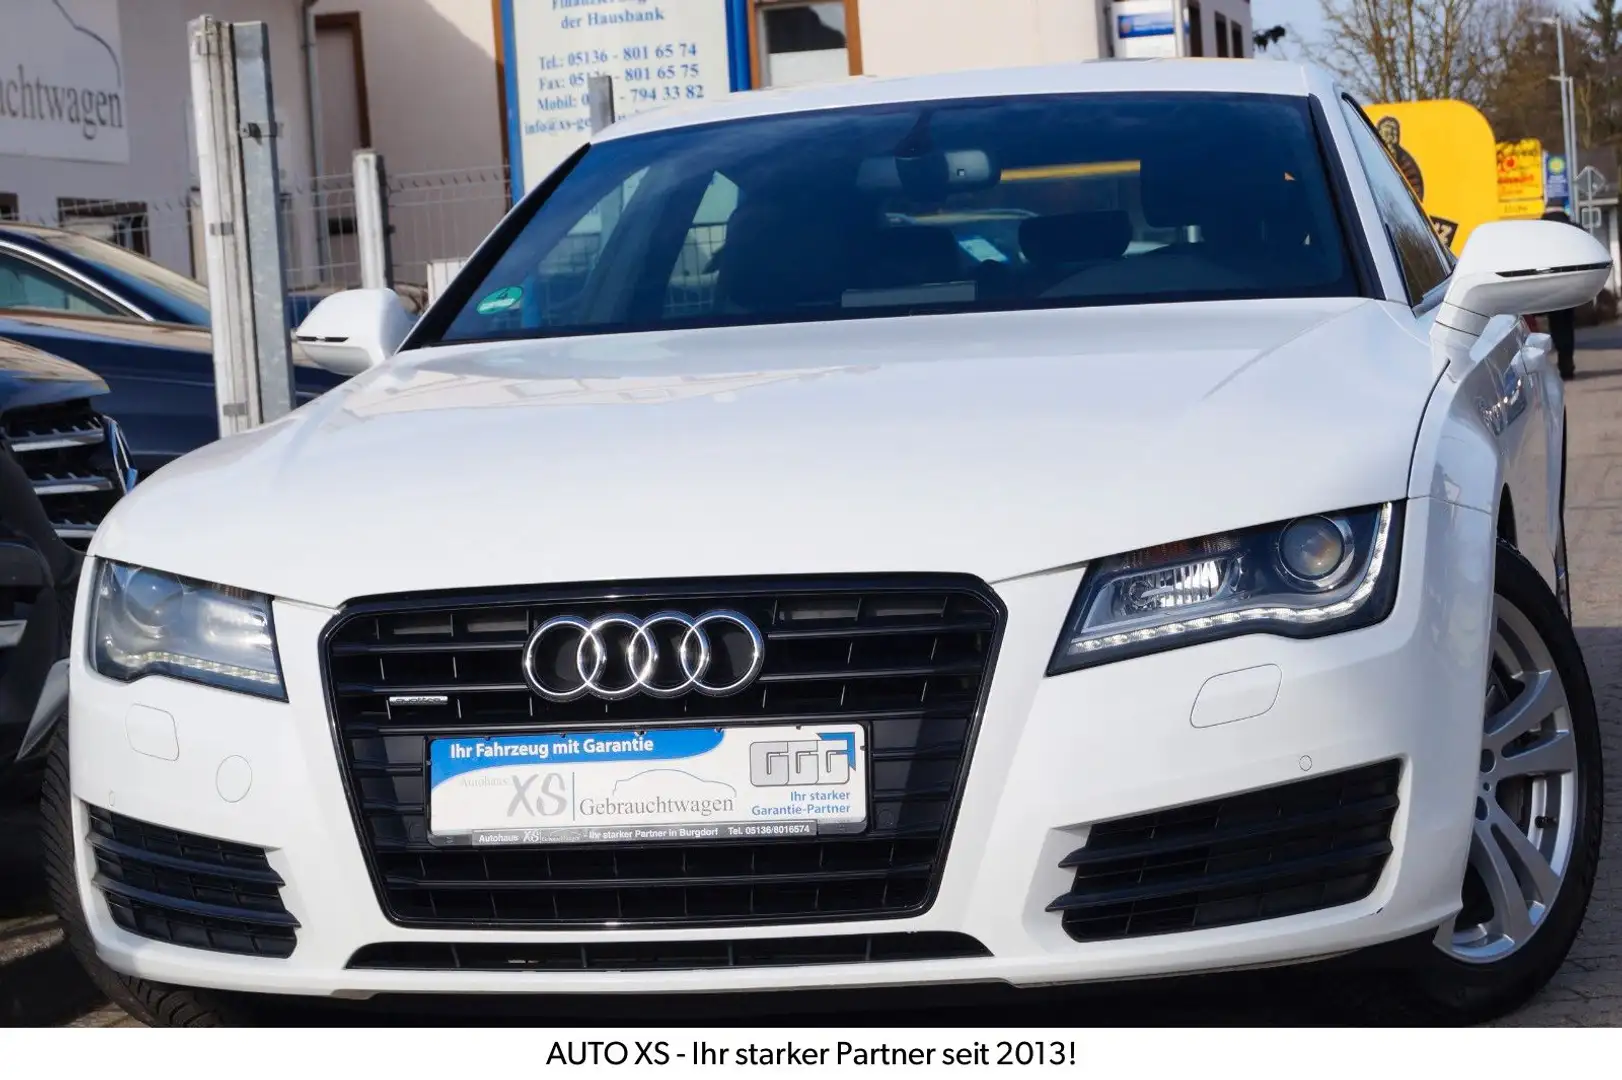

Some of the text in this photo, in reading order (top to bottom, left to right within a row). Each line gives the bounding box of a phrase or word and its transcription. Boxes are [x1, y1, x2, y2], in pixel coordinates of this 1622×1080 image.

[560, 7, 665, 29] der Hausbank
[567, 50, 608, 66] 05136
[623, 46, 649, 61] 801
[655, 45, 674, 58] 65
[679, 43, 697, 57] 74
[538, 76, 566, 91] Fax:
[624, 67, 651, 81] 801
[657, 64, 676, 79] 65
[680, 63, 699, 78] 75
[537, 95, 577, 112] Mobil:
[630, 88, 657, 103] 794
[663, 86, 680, 101] 33
[686, 85, 705, 99] 82
[450, 737, 654, 759] Ihr Fahrzeug mit Garantie
[506, 772, 567, 817] XS
[580, 796, 734, 817] Gebrauchtwagen
[790, 790, 851, 801] Ihr starker
[751, 803, 851, 816] Garantie-Partner
[478, 833, 520, 843] Autohaus
[589, 831, 602, 839] Ihr
[603, 829, 632, 839] starker
[635, 828, 667, 838] Partner
[669, 828, 678, 837] in
[680, 826, 719, 838] Burgdorf
[728, 826, 743, 836] Tel.
[745, 823, 811, 835] 05136/8016574
